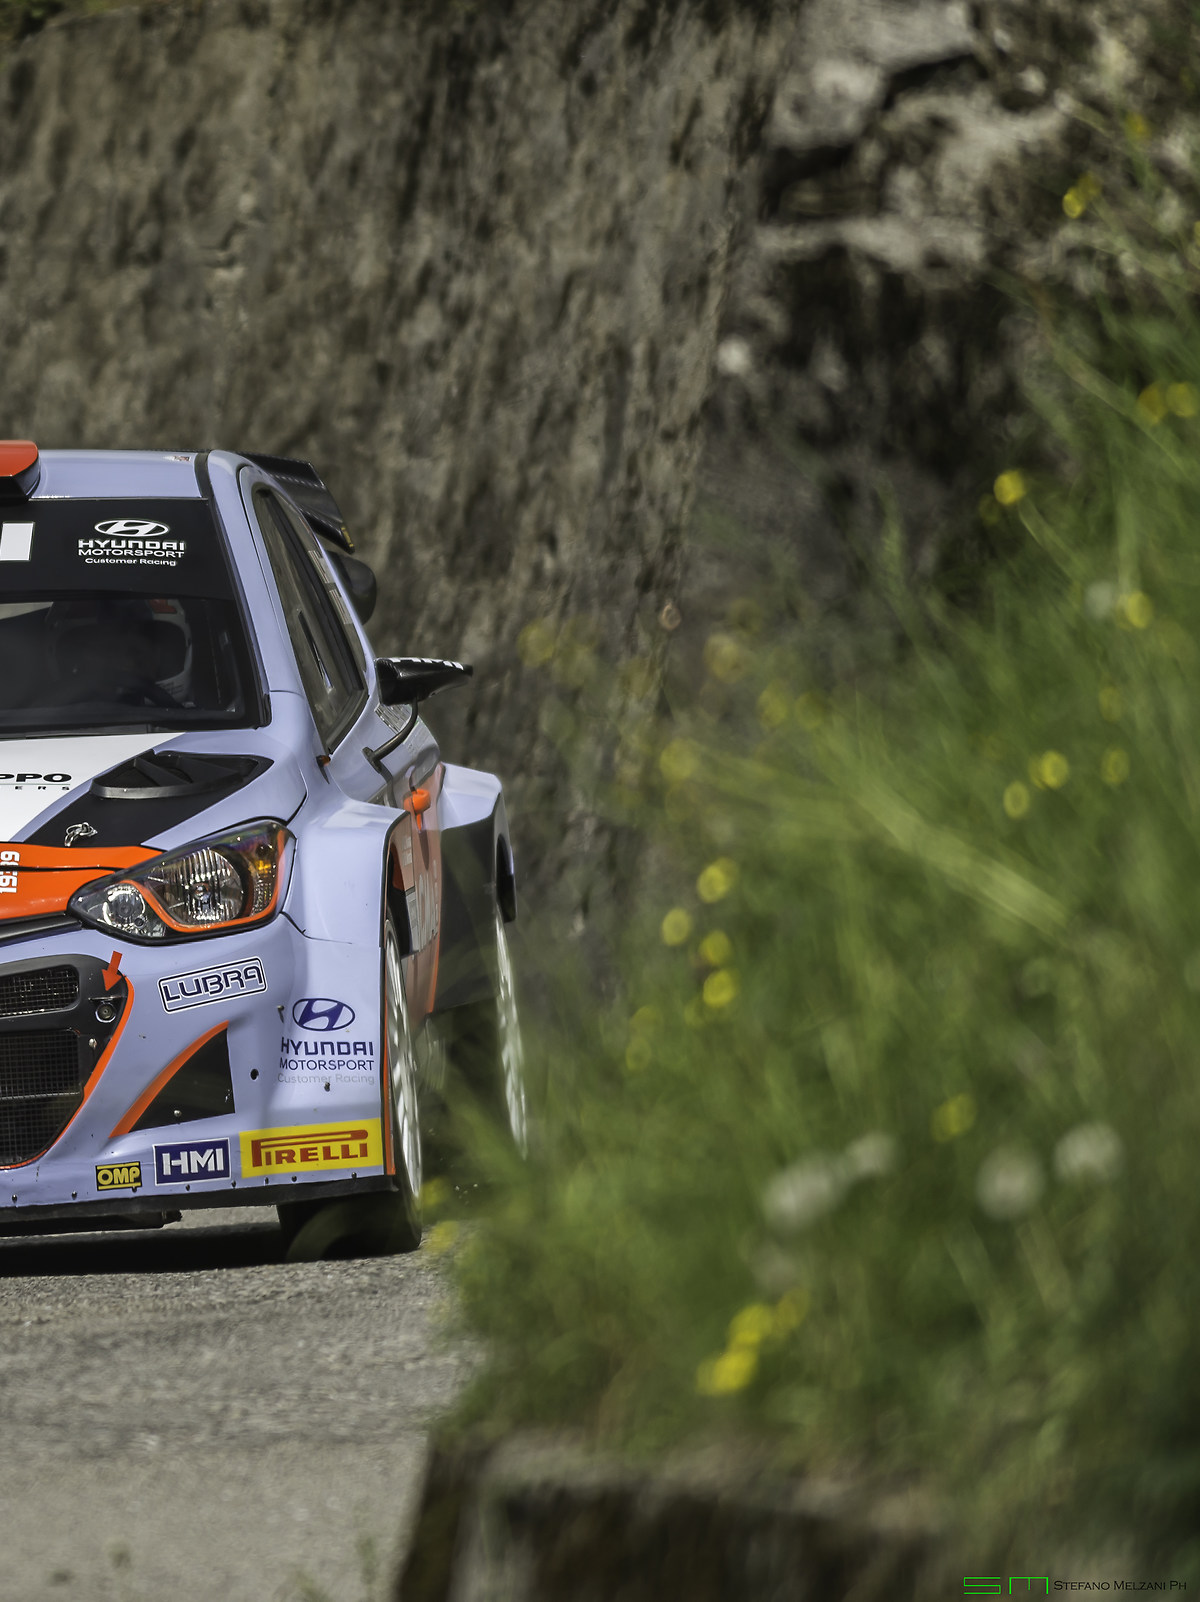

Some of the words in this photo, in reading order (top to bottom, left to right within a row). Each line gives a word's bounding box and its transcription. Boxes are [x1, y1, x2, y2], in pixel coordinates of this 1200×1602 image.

[77, 540, 186, 551] HYUNDAI
[78, 549, 185, 558] MOTORSPORT
[84, 557, 138, 565] Customer
[139, 558, 177, 567] Racing
[162, 964, 265, 1002] LUBRA
[280, 1036, 374, 1056] HYUNDAI
[279, 1057, 375, 1071] MOTORSPORT
[277, 1072, 333, 1085] Customer
[335, 1072, 375, 1086] Racing
[251, 1129, 369, 1168] PIRELLI
[162, 1148, 224, 1176] HMI
[97, 1168, 141, 1186] OMP
